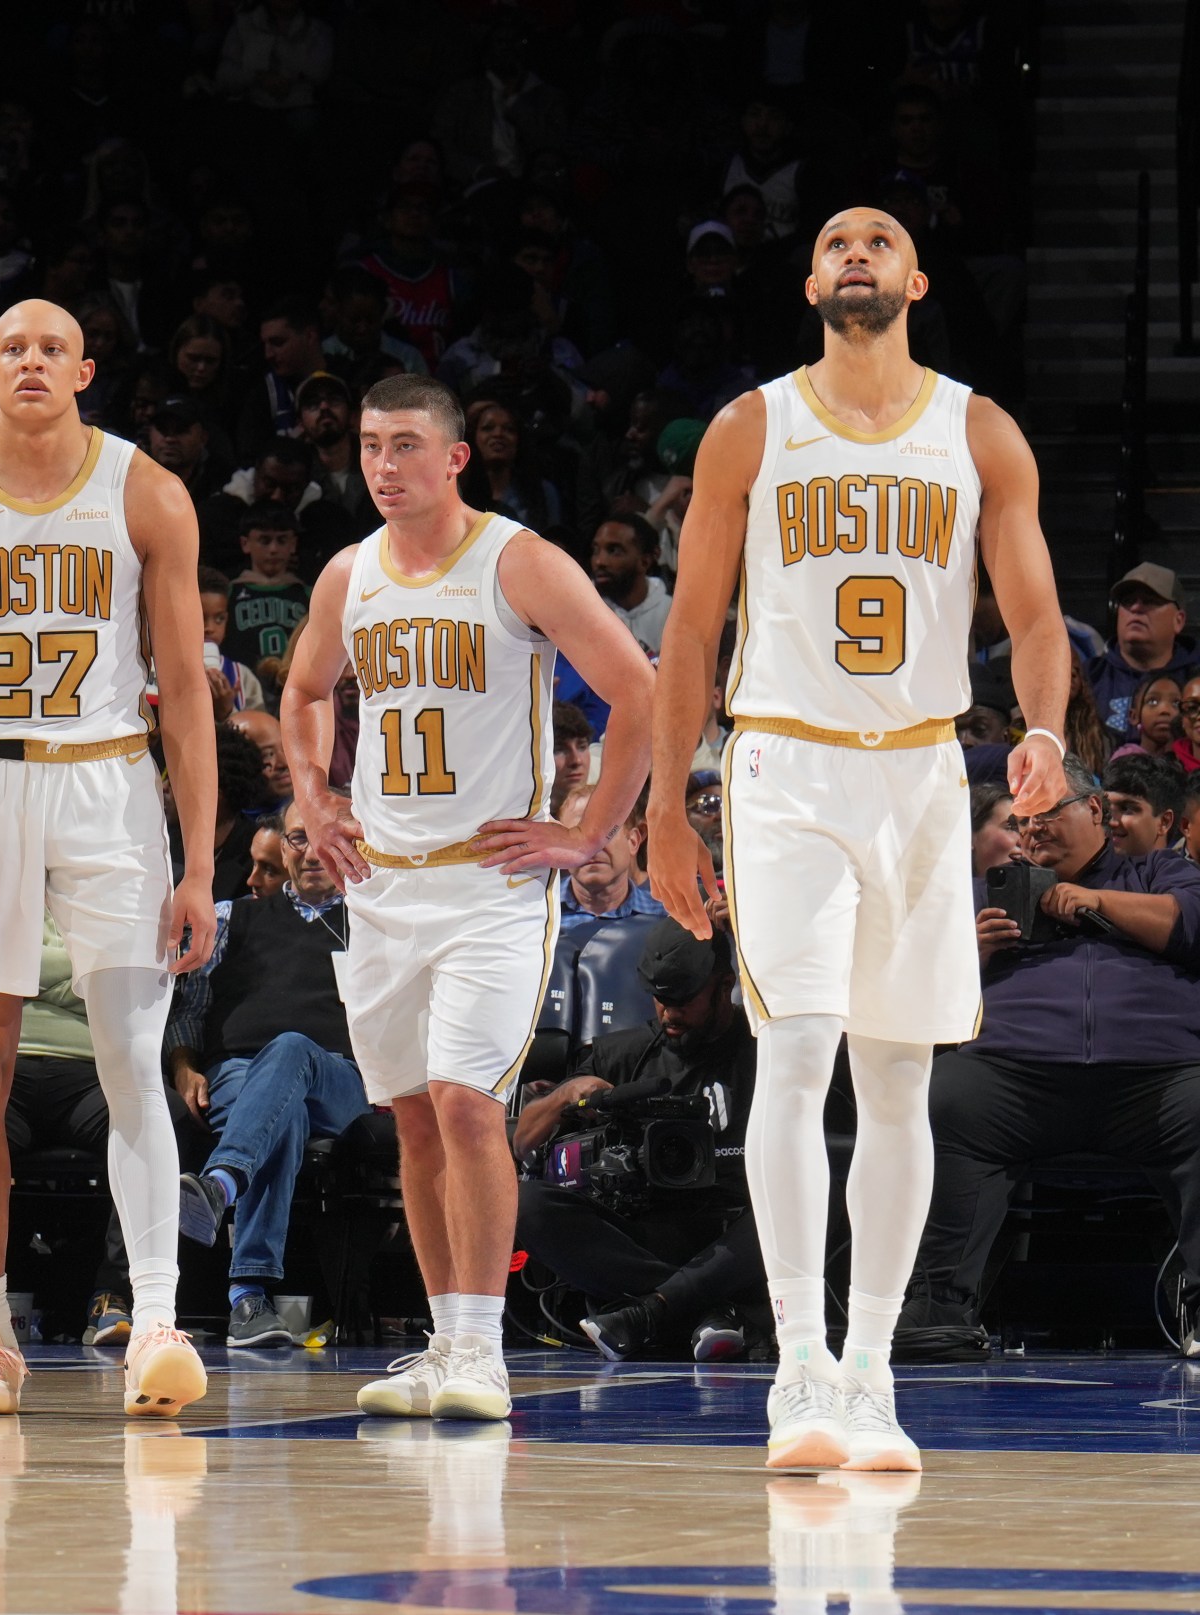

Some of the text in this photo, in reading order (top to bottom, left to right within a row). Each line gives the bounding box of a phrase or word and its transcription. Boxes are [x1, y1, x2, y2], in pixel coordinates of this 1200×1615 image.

[900, 441, 948, 457] Amica
[66, 508, 109, 521] Amica
[776, 474, 957, 570] BOSTON
[436, 584, 477, 598] Amica
[835, 575, 906, 676] 9
[353, 617, 486, 700] BOSTON
[380, 708, 457, 796] 11
[550, 989, 565, 999] SEAT
[601, 1001, 614, 1011] SEC
[714, 1146, 746, 1157] eacoc
